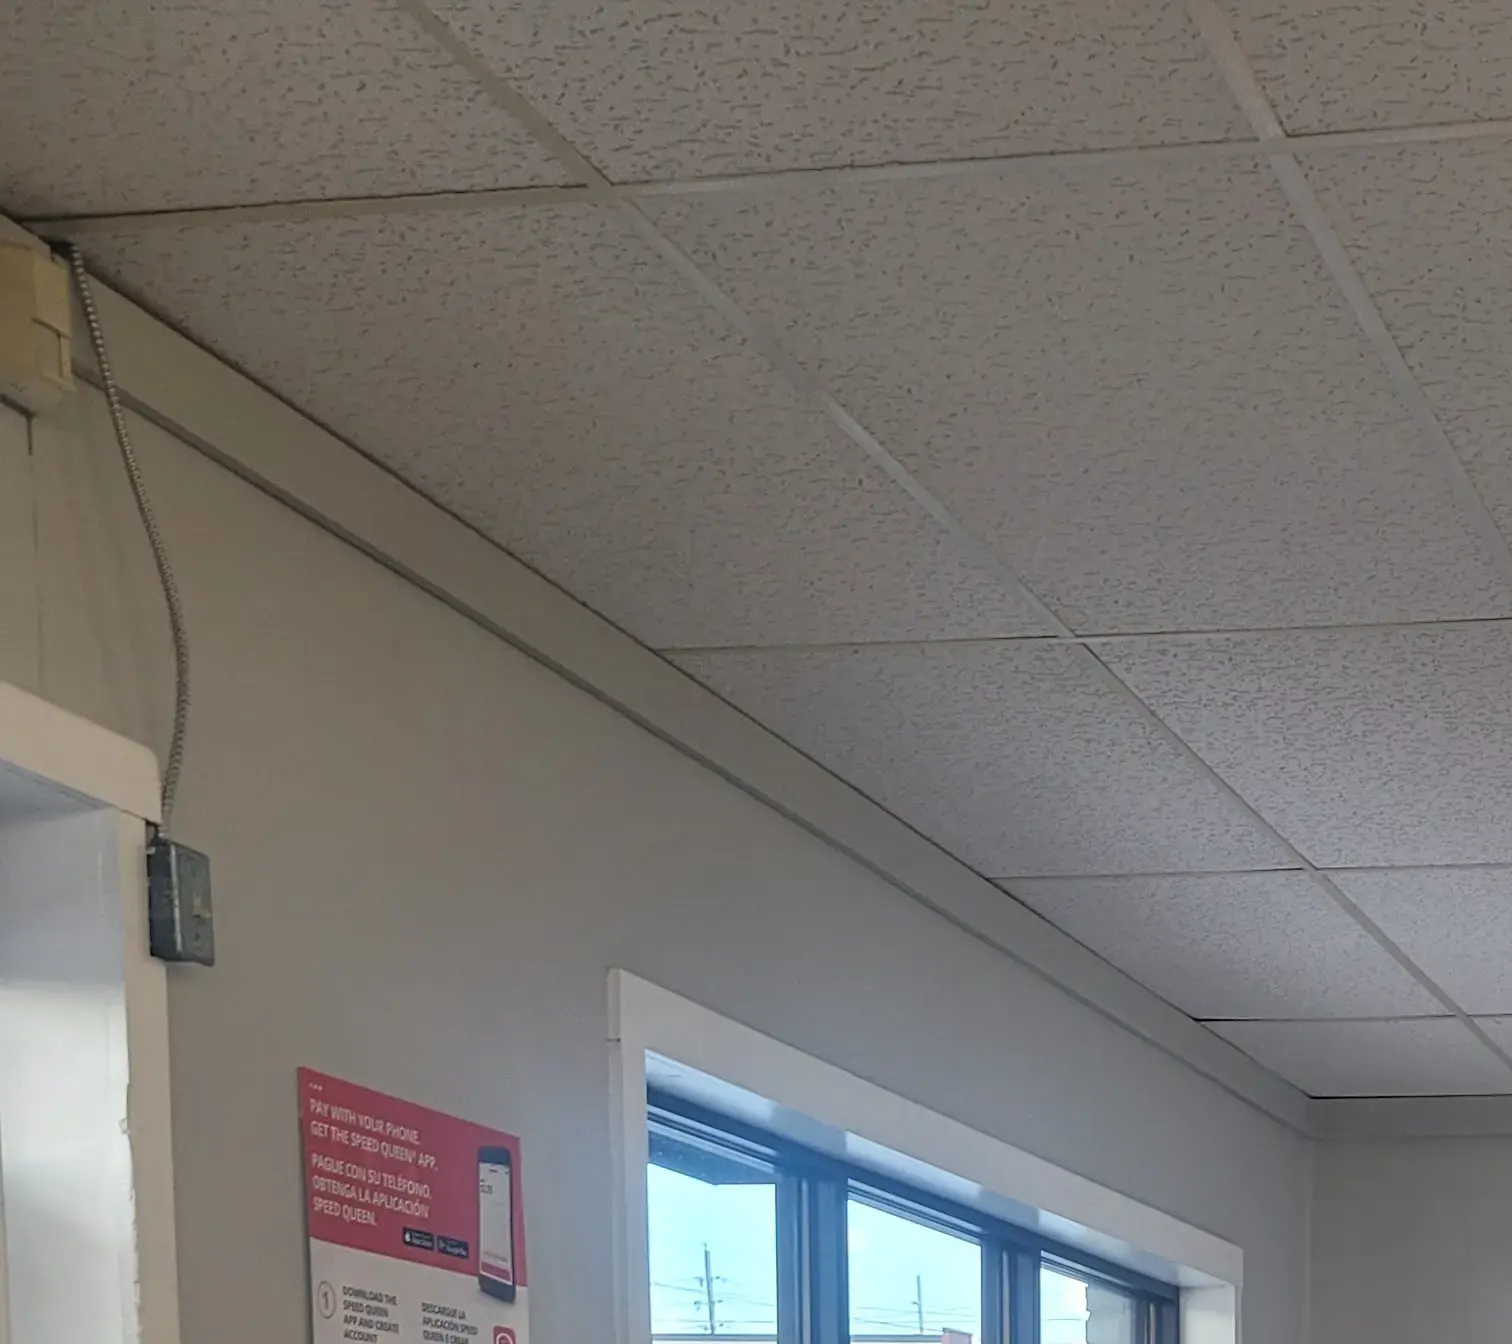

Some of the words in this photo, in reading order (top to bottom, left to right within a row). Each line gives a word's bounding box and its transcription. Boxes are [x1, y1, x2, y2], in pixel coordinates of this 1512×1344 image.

[310, 1098, 330, 1116] PAY
[331, 1104, 357, 1125] WITH
[357, 1113, 385, 1133] YOUR
[386, 1121, 421, 1145] PHONE.
[310, 1121, 329, 1138] GET
[330, 1126, 349, 1145] THE
[351, 1131, 380, 1153] SPEED
[417, 1152, 440, 1171] APP.
[312, 1153, 344, 1175] PAGUE
[346, 1163, 367, 1181] CON
[368, 1169, 381, 1185] SU
[313, 1175, 358, 1199] OBTENGA
[359, 1187, 371, 1203] LA
[372, 1192, 430, 1219] APLICACIÓN
[313, 1197, 341, 1217] SPEED
[323, 1290, 329, 1309] 1
[343, 1286, 383, 1302] DOWNLOAD
[385, 1293, 398, 1306] THE
[343, 1300, 364, 1313] SPEED
[365, 1305, 389, 1318] QUEEN
[344, 1314, 358, 1325] APP
[358, 1318, 374, 1329] AND
[375, 1321, 399, 1334] CREATE
[344, 1328, 378, 1343] ACCOUNT
[422, 1330, 445, 1342] QUEEN
